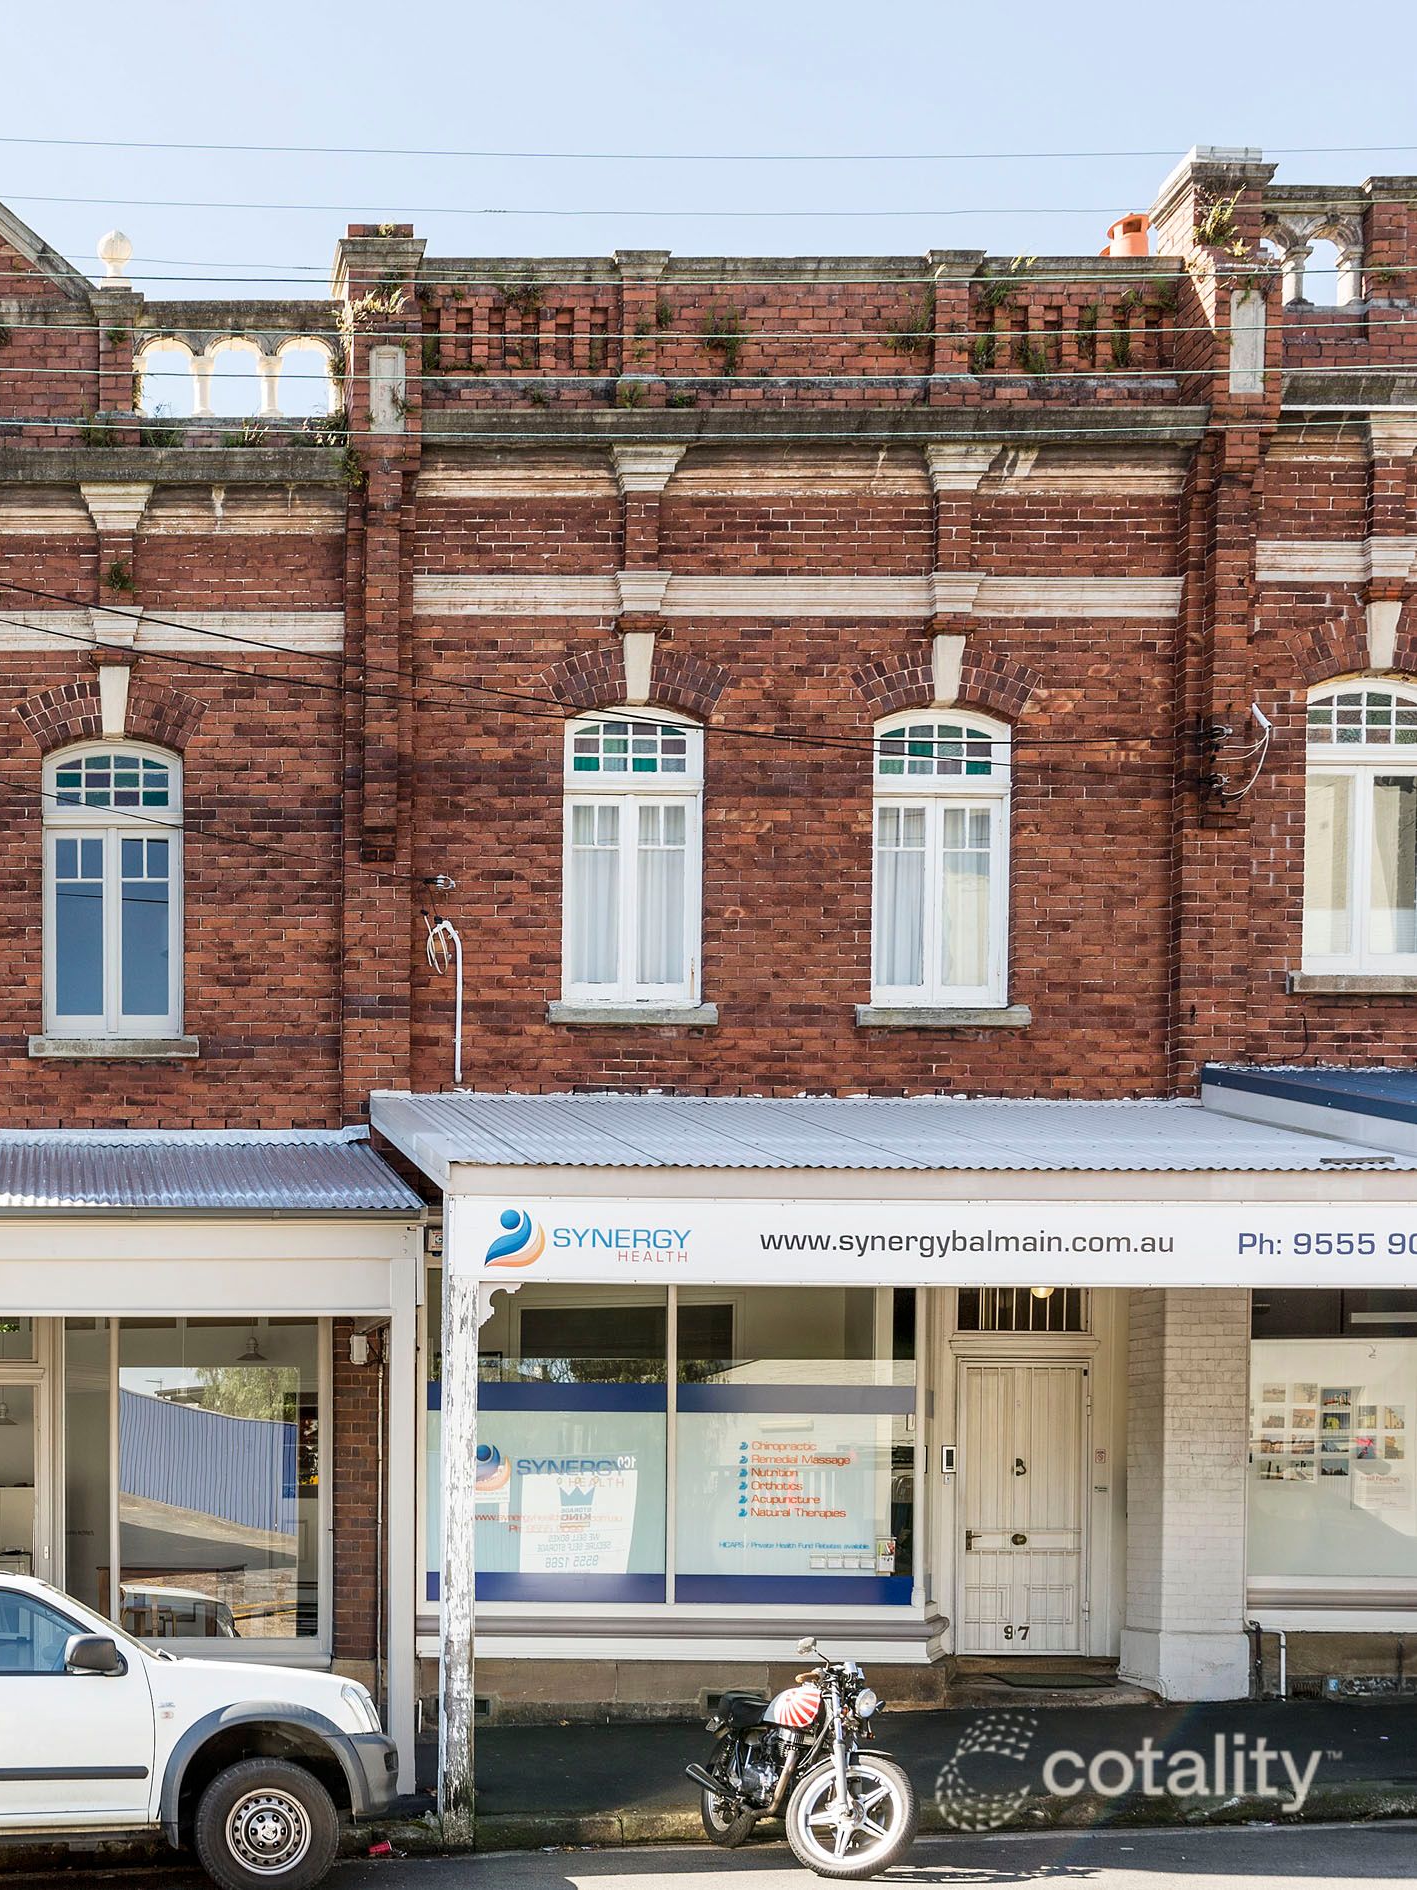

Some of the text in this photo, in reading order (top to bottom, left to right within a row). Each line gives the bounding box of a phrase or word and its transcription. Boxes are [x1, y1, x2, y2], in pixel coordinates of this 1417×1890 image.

[553, 1228, 692, 1249] SYNERGY
[760, 1230, 1174, 1258] www.synergybalmain.com.au
[1238, 1233, 1282, 1255] Ph:
[1293, 1232, 1376, 1255] 9555
[617, 1250, 688, 1263] HEALTH
[751, 1441, 817, 1452] Chiropractic
[751, 1454, 851, 1466] Remedial Massage
[516, 1459, 627, 1476] SYNERGY
[751, 1468, 798, 1477] Nutrition
[568, 1479, 624, 1488] HEALTH
[751, 1481, 803, 1491] Orthotics
[751, 1494, 821, 1505] Acupuncture
[750, 1508, 847, 1520] Natural Therapies
[1003, 1625, 1030, 1641] 97
